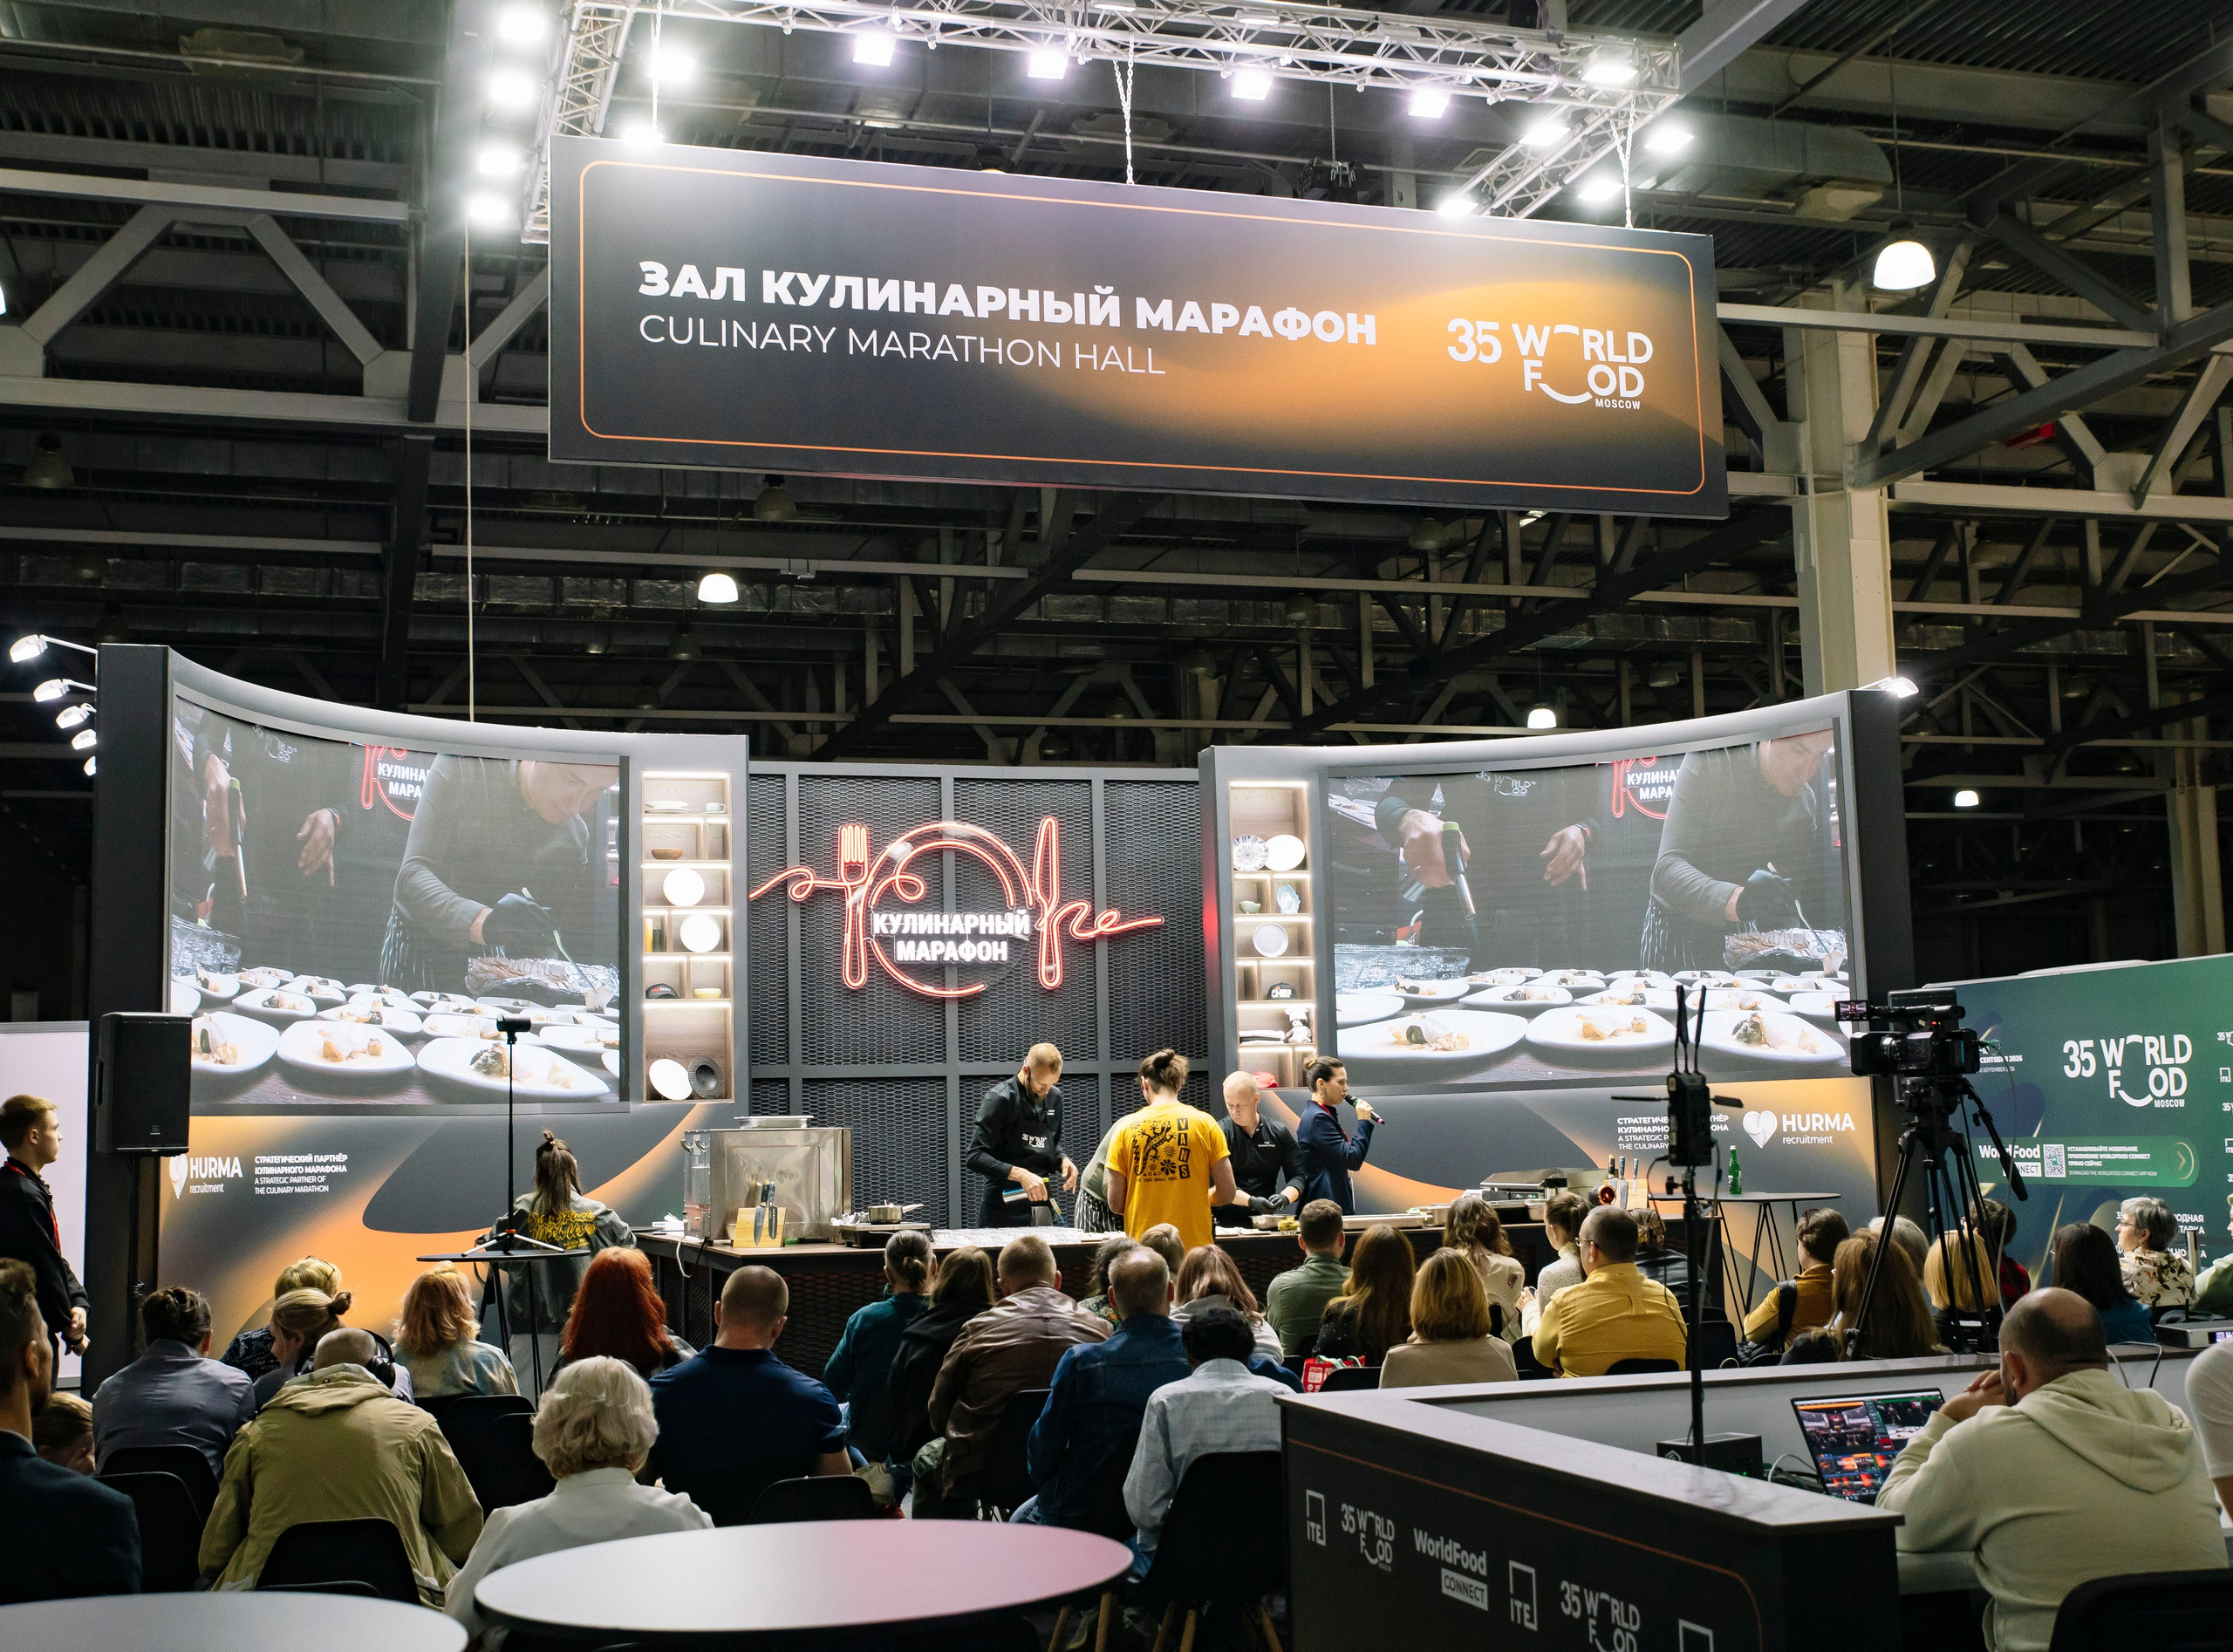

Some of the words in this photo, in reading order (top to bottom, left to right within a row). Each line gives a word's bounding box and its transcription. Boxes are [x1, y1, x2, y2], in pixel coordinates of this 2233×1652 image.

[638, 261, 746, 302] ЗАЛ
[761, 270, 1121, 327] КУЛИНАРНЫЙ
[1136, 297, 1377, 345] МАРАФОН
[639, 314, 837, 353] CULINARY
[848, 328, 1062, 368] MARATHON
[1075, 343, 1165, 375] HALL
[1447, 317, 1503, 365] 35
[1595, 398, 1641, 410] MOSCOW
[389, 782, 422, 799] МАРА
[1639, 785, 1673, 800] МАРА
[873, 909, 1030, 935] КУЛИНАРНЫЙ
[896, 939, 1008, 962] МАРАФОН
[2063, 1039, 2097, 1078] 35
[2154, 1099, 2185, 1108] MOSCOW
[1617, 1125, 1670, 1134] КУЛИНАРНО
[1782, 1113, 1856, 1132] HURMA
[1178, 1118, 1191, 1179] VANS
[1783, 1135, 1834, 1144] recruitment
[255, 1154, 313, 1164] СТРАТЕГИЧЕСКИЙ
[314, 1153, 348, 1163] ПАРТНЁР
[1978, 1144, 2041, 1159] WodFood
[190, 1157, 243, 1179] HURMA
[255, 1165, 304, 1175] КУЛИНАРНОГО
[304, 1164, 347, 1174] МАРАФОНА
[2018, 1165, 2038, 1174] NECT
[190, 1183, 224, 1193] recruitment
[295, 1184, 329, 1193] MARATHON
[2174, 1213, 2204, 1224] ОДНАЯ
[1341, 1502, 1356, 1534] 35
[1413, 1527, 1488, 1576] WorldFood
[1444, 1573, 1485, 1604] CONNECT
[1560, 1579, 1581, 1619] 35
